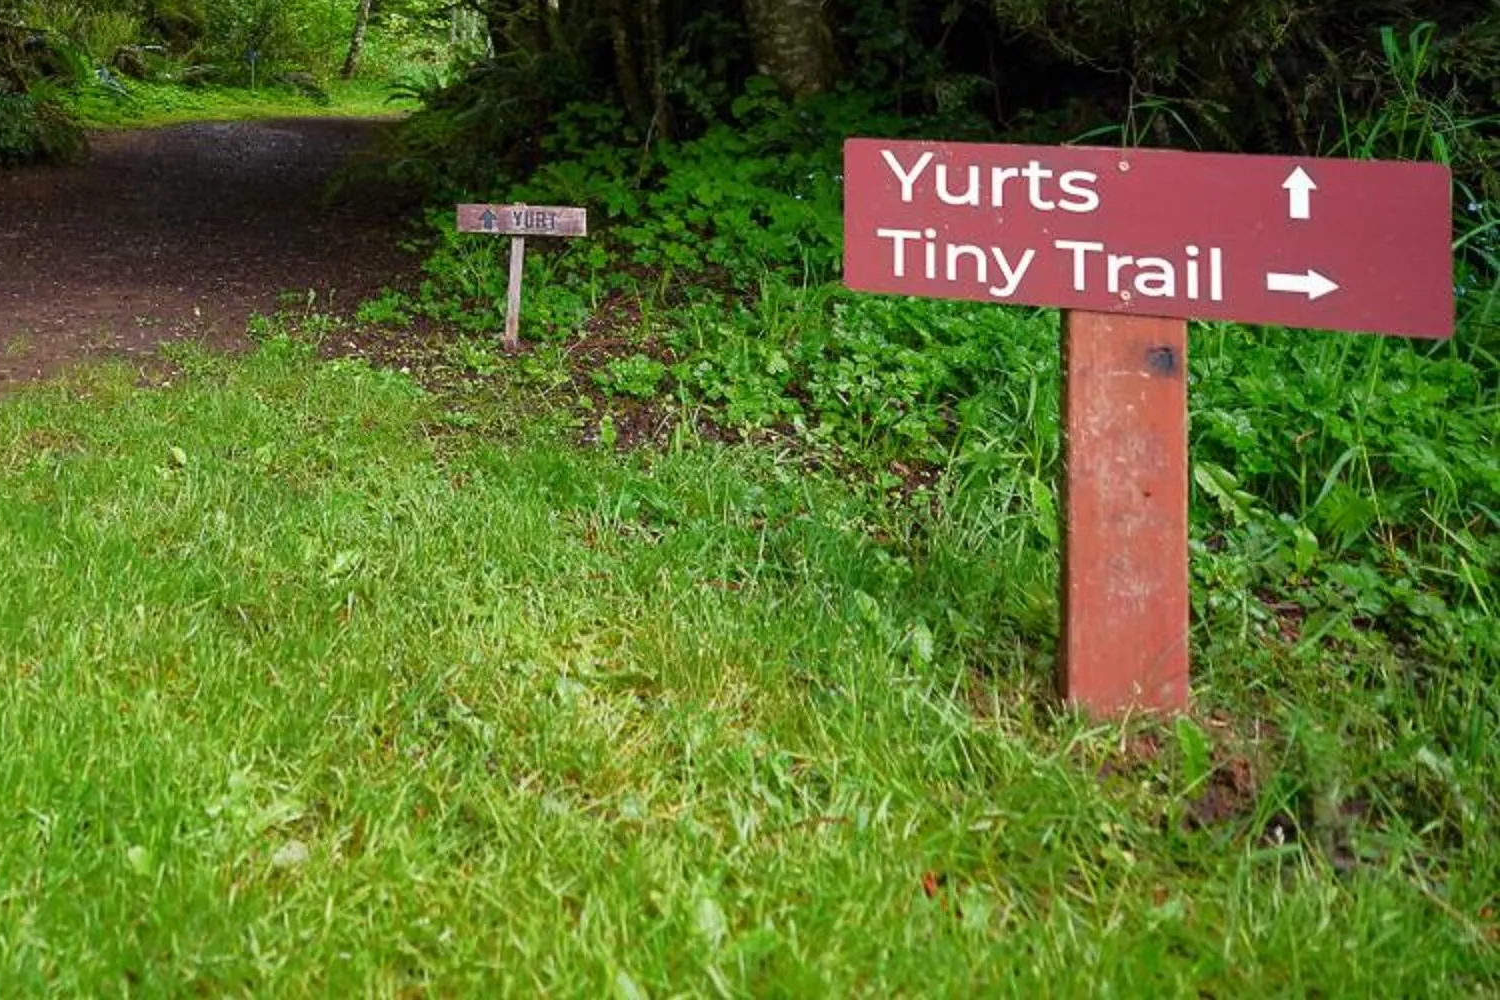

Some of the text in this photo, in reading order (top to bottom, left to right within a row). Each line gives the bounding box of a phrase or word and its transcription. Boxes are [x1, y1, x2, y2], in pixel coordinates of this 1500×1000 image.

[880, 149, 1100, 213] Yurts
[511, 210, 557, 230] YURT
[876, 228, 1224, 302] Tiny Trail
